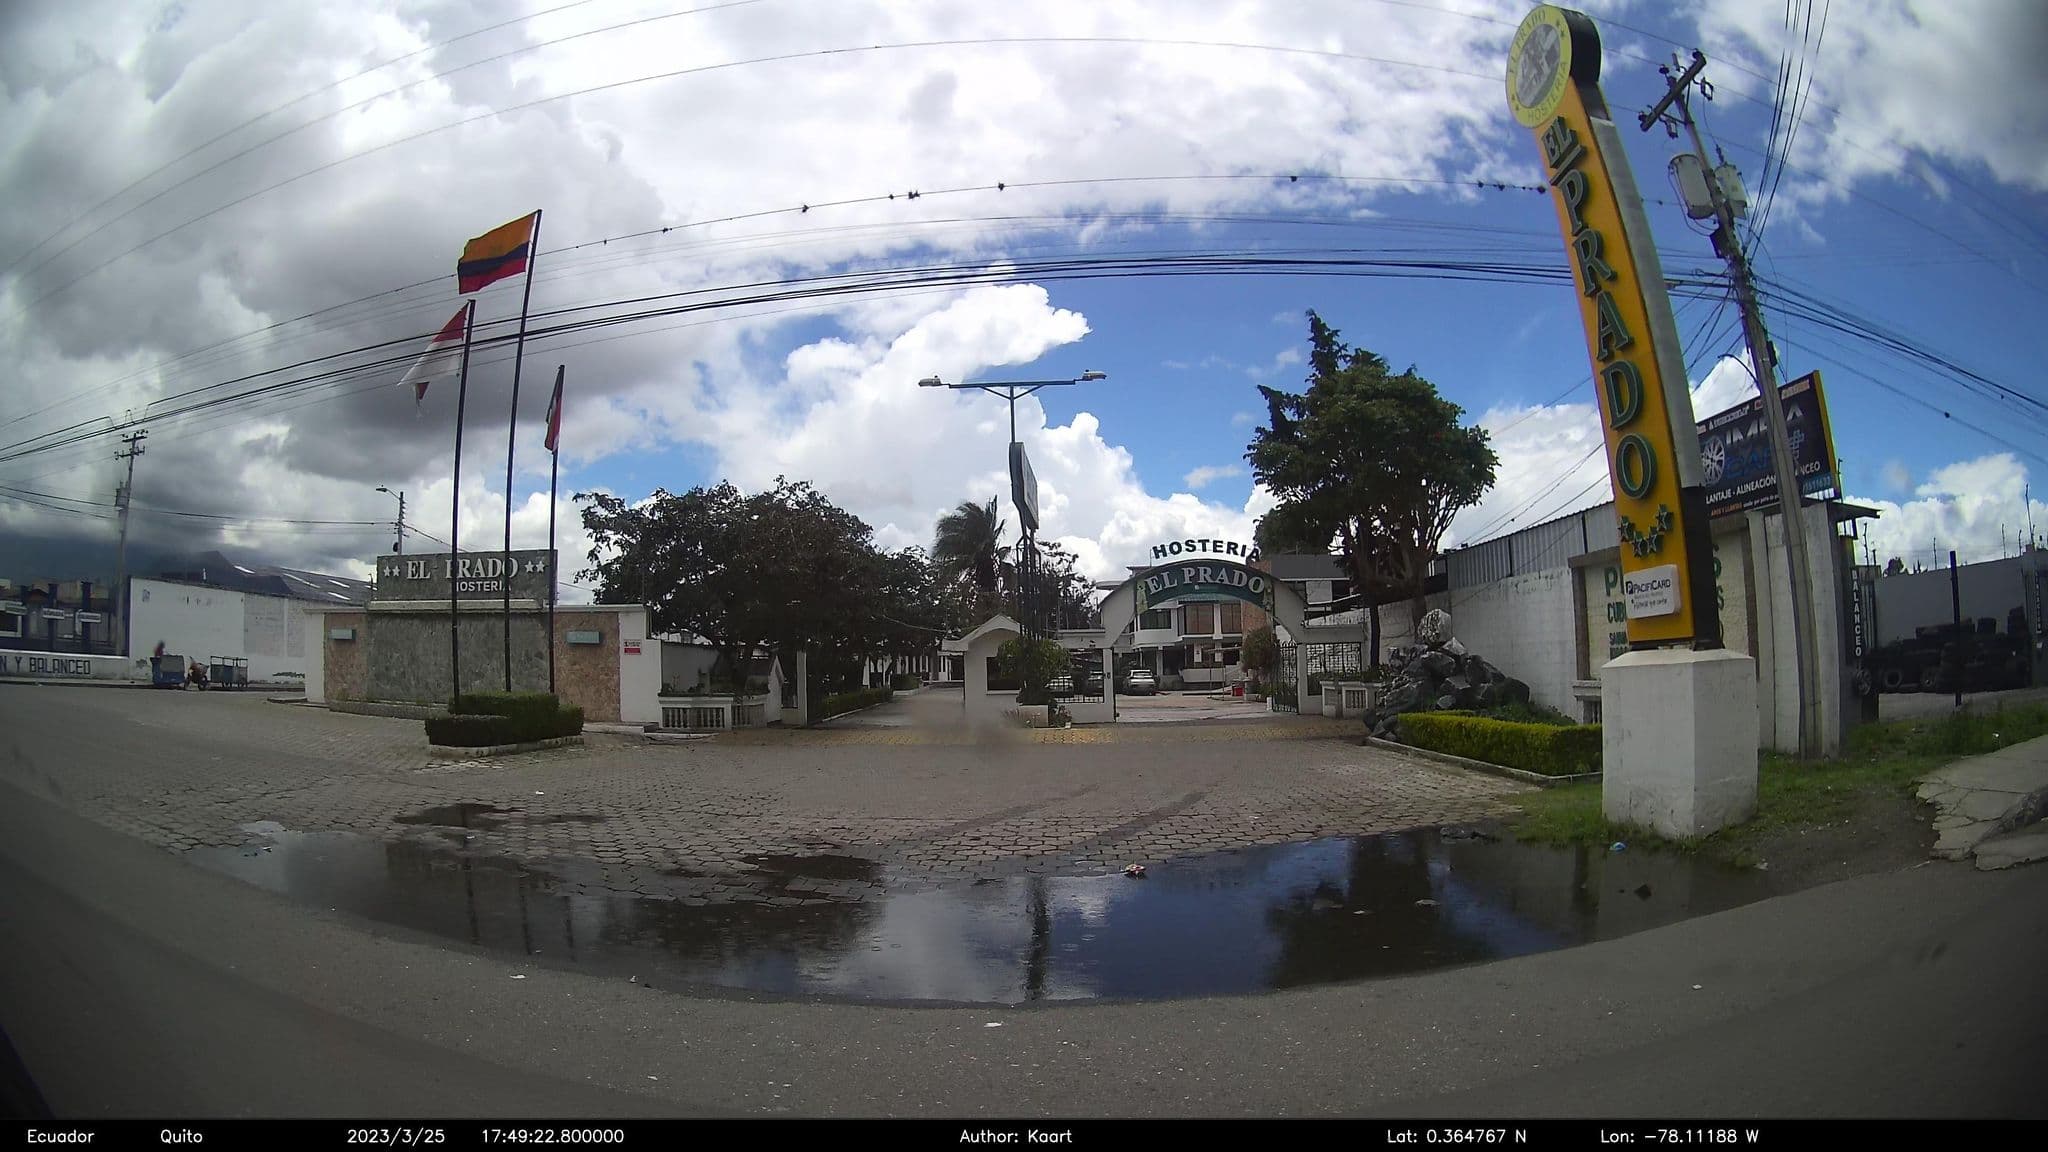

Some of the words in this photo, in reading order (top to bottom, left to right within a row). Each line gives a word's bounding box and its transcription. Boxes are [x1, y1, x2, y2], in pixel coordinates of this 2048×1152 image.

[1541, 116, 1577, 169] EL
[1558, 170, 1657, 500] PRADO
[1736, 473, 1777, 496] ALINEACIÓN
[1152, 539, 1261, 561] HOSTERIA
[406, 560, 431, 579] EL
[1145, 571, 1178, 594] EL
[1182, 566, 1265, 594] PRADO
[1633, 579, 1671, 593] PACIFICARD
[1852, 570, 1862, 656] BALANCEO
[15, 656, 22, 672] Y
[29, 657, 91, 675] BALANCEO
